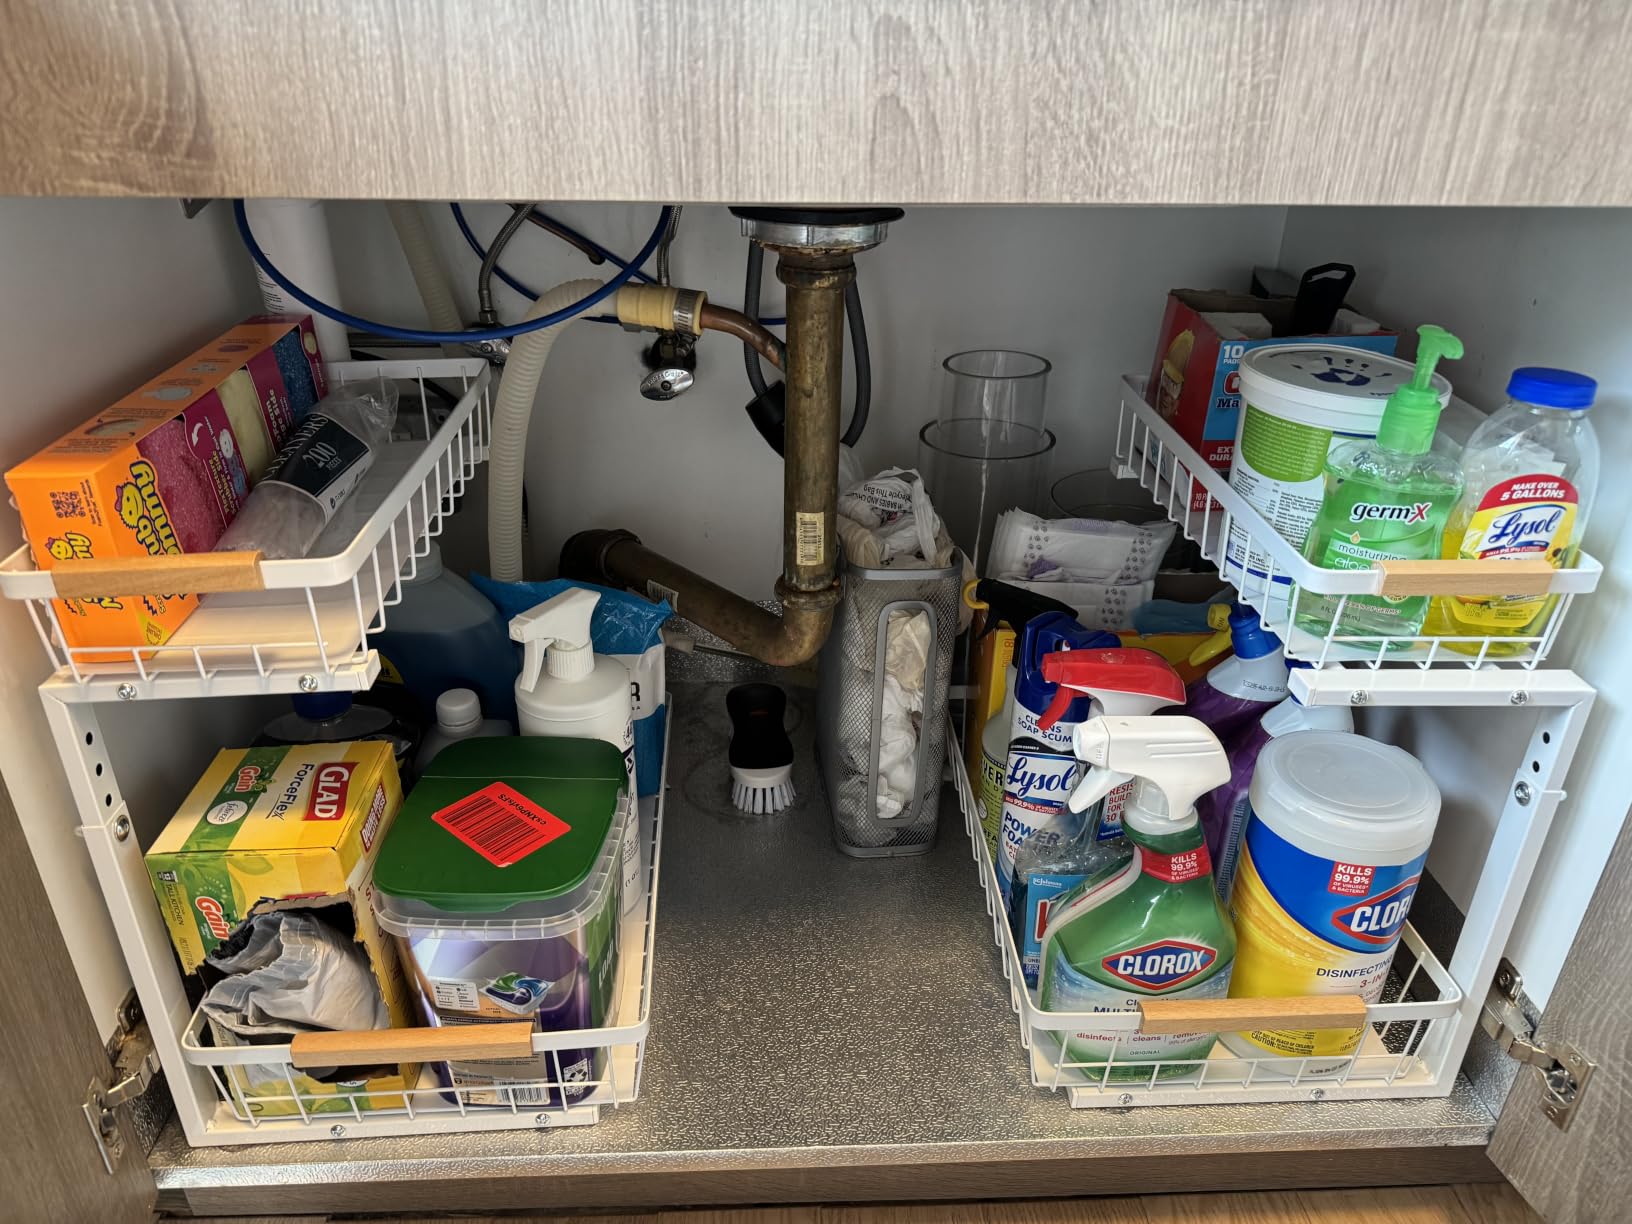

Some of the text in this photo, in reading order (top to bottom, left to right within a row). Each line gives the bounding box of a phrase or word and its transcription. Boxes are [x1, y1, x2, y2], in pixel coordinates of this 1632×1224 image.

[1223, 345, 1244, 358] 10
[302, 442, 336, 468] 200
[1500, 490, 1566, 500] 5 GALLONS
[1511, 482, 1536, 491] MAKE
[1350, 502, 1432, 525] germ-X
[1488, 510, 1562, 545] Lysol
[1025, 714, 1062, 734] CLENS
[1041, 731, 1072, 743] SCUM
[234, 765, 261, 792] Gain
[1007, 757, 1077, 797] Lysol
[272, 763, 315, 821] ForceFlex
[315, 766, 350, 818] GLAD
[1105, 813, 1117, 822] 30
[1003, 825, 1025, 846] FOA
[1171, 853, 1197, 863] KILLS
[1171, 861, 1197, 871] 99.9%
[1334, 873, 1370, 885] 99.9%
[1337, 864, 1372, 876] KILLS
[171, 898, 184, 926] KITCHEN
[195, 896, 230, 940] Gain
[1118, 949, 1206, 976] CLOROX
[1251, 1032, 1277, 1048] CAUTION:
[1276, 1038, 1289, 1046] REACH
